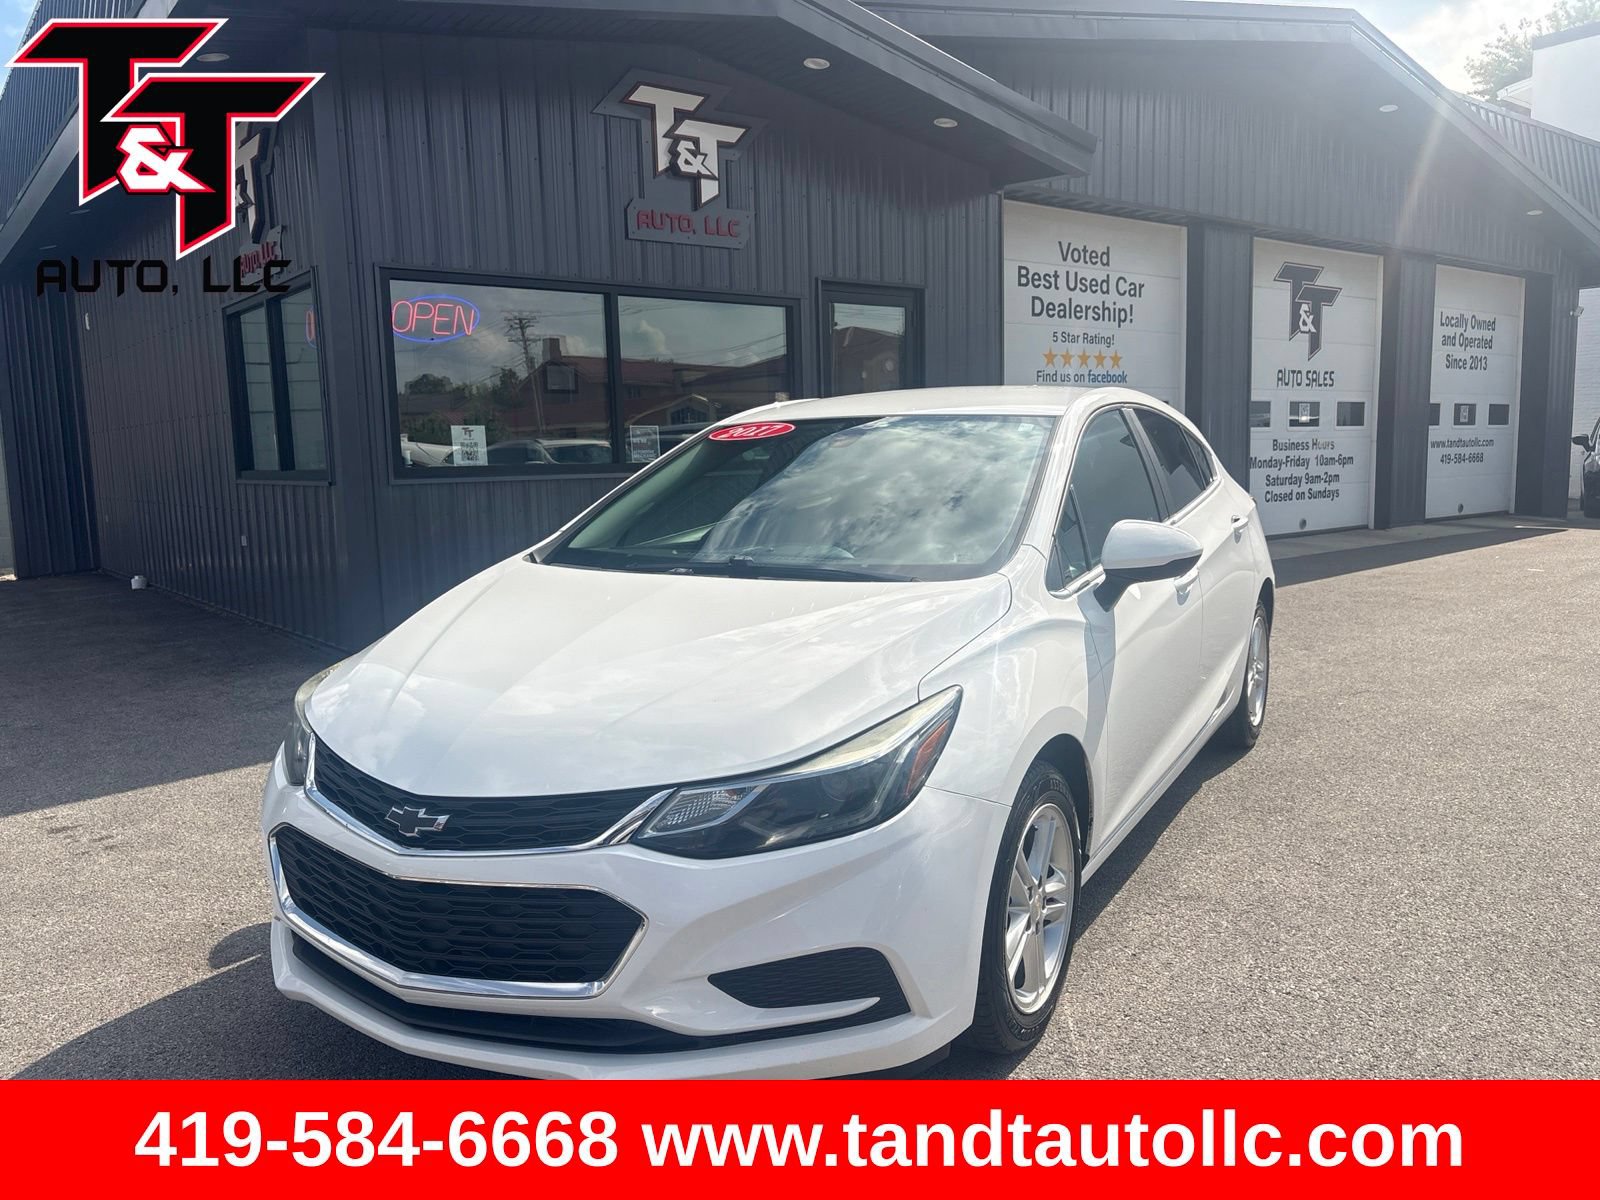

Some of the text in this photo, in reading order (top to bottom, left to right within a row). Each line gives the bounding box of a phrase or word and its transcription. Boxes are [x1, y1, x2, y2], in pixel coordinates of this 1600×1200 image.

[704, 216, 741, 238] LLC
[1058, 241, 1110, 267] Voted
[1017, 265, 1145, 299] Best Used Car
[391, 300, 475, 336] OPEN
[1031, 295, 1134, 328] Dealership!
[1440, 311, 1496, 333] Locally Owned
[1052, 331, 1115, 348] 5 Star Rating!
[1441, 332, 1493, 351] and Operated
[1445, 353, 1488, 371] Since 2013
[1036, 369, 1128, 384] Find us on facebook
[1276, 368, 1335, 388] AUTO SALES
[1272, 439, 1310, 452] Business
[1249, 453, 1354, 471] Monday-Friday 10am-6pm
[1440, 452, 1484, 465] 419-584-6668
[1265, 472, 1340, 488] Saturday 9am-2pm
[1264, 487, 1340, 503] Closed on Sundays
